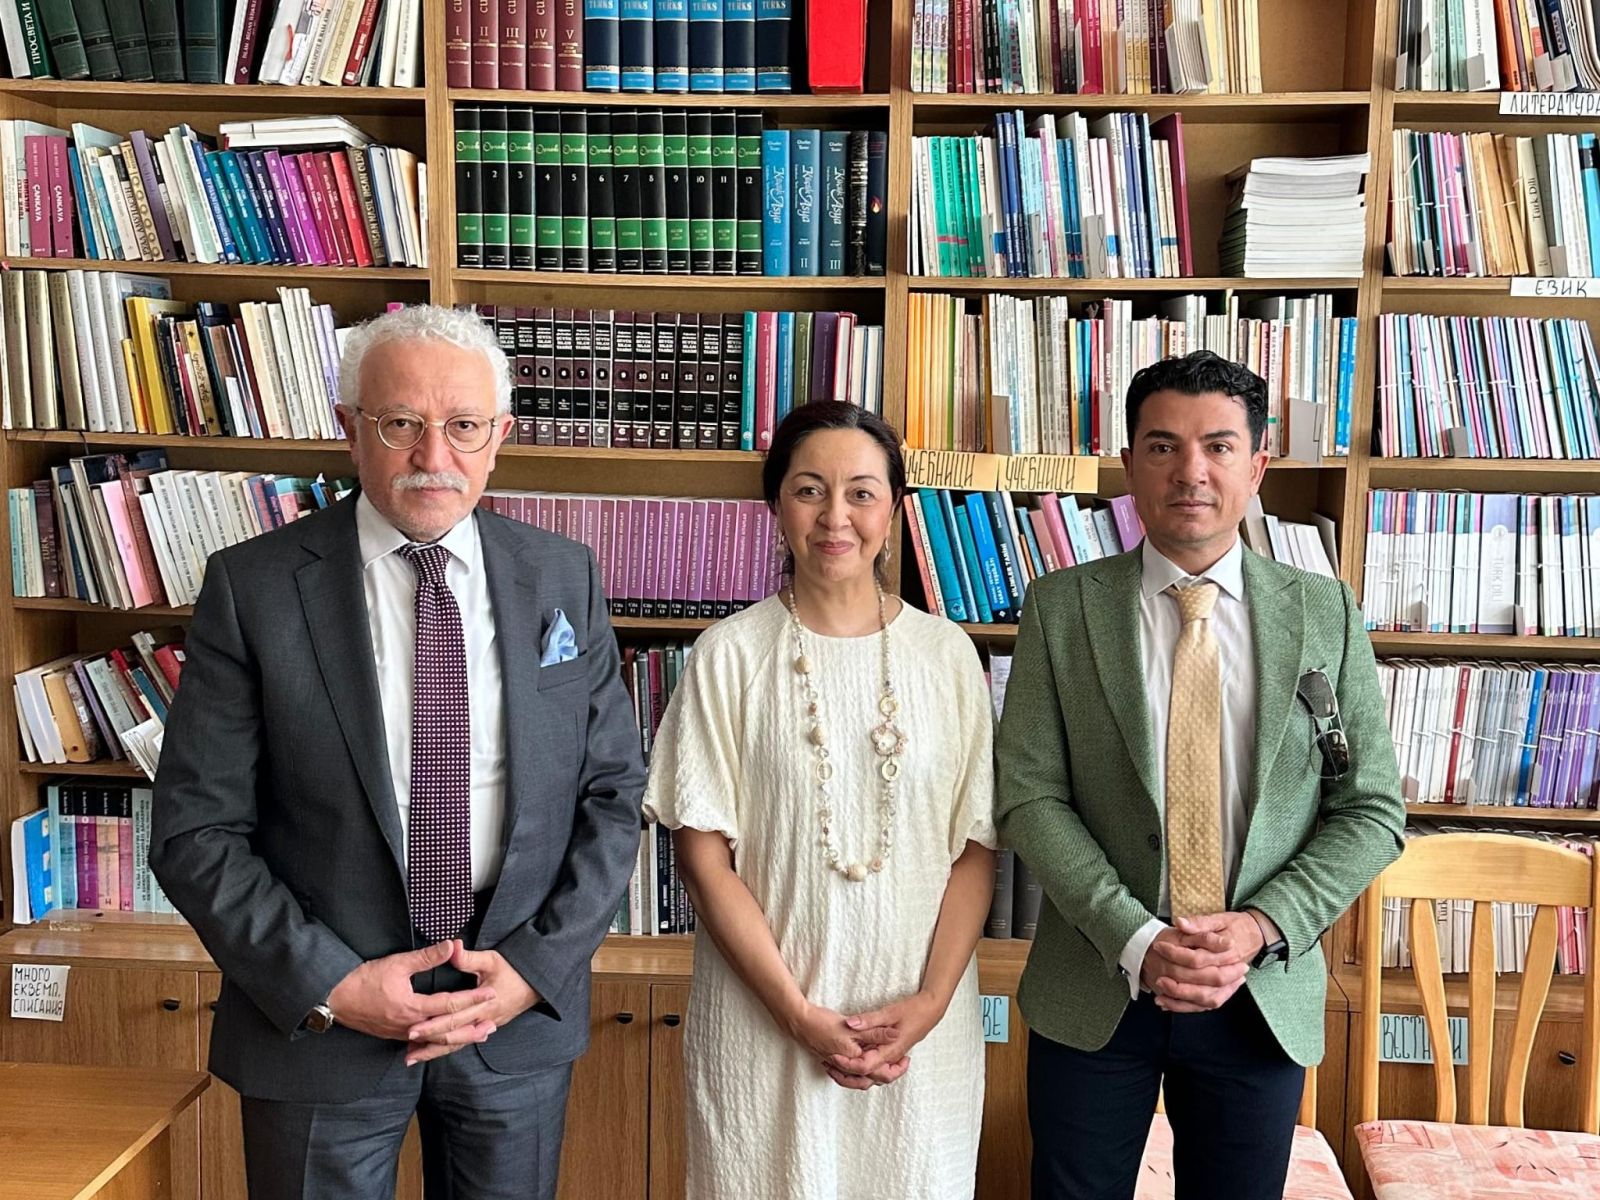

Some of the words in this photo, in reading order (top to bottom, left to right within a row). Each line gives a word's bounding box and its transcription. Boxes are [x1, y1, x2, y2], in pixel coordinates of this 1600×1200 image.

[589, 1, 613, 9] TURKS
[624, 1, 647, 9] TURKS
[659, 1, 682, 10] TURKS
[693, 2, 717, 11] TURKS
[728, 1, 752, 11] TURKS
[763, 1, 786, 9] TURKS
[480, 27, 488, 36] II
[506, 28, 519, 37] III
[535, 29, 546, 38] IV
[566, 30, 574, 39] V
[24, 12, 41, 64] ПРОСВЕТА
[1528, 178, 1538, 195] Dili
[32, 184, 41, 221] ÇANKAYA
[54, 185, 64, 222] ÇANKAYA
[1532, 198, 1541, 222] Türk
[801, 258, 808, 268] II
[830, 260, 840, 269] III
[1535, 280, 1588, 298] ЕЗИК
[746, 324, 750, 332] 1
[764, 324, 768, 332] 1
[800, 324, 805, 332] 2
[824, 324, 829, 332] 3
[1005, 457, 1077, 492] УЧЕБНИЦИ
[15, 968, 50, 982] МНОГО
[14, 982, 60, 997] ЕКЗЕМП.
[14, 999, 63, 1015] СПИСАНИЯ
[983, 997, 1001, 1036] ВЕ
[1383, 1015, 1461, 1059] ВЕСТНИ
